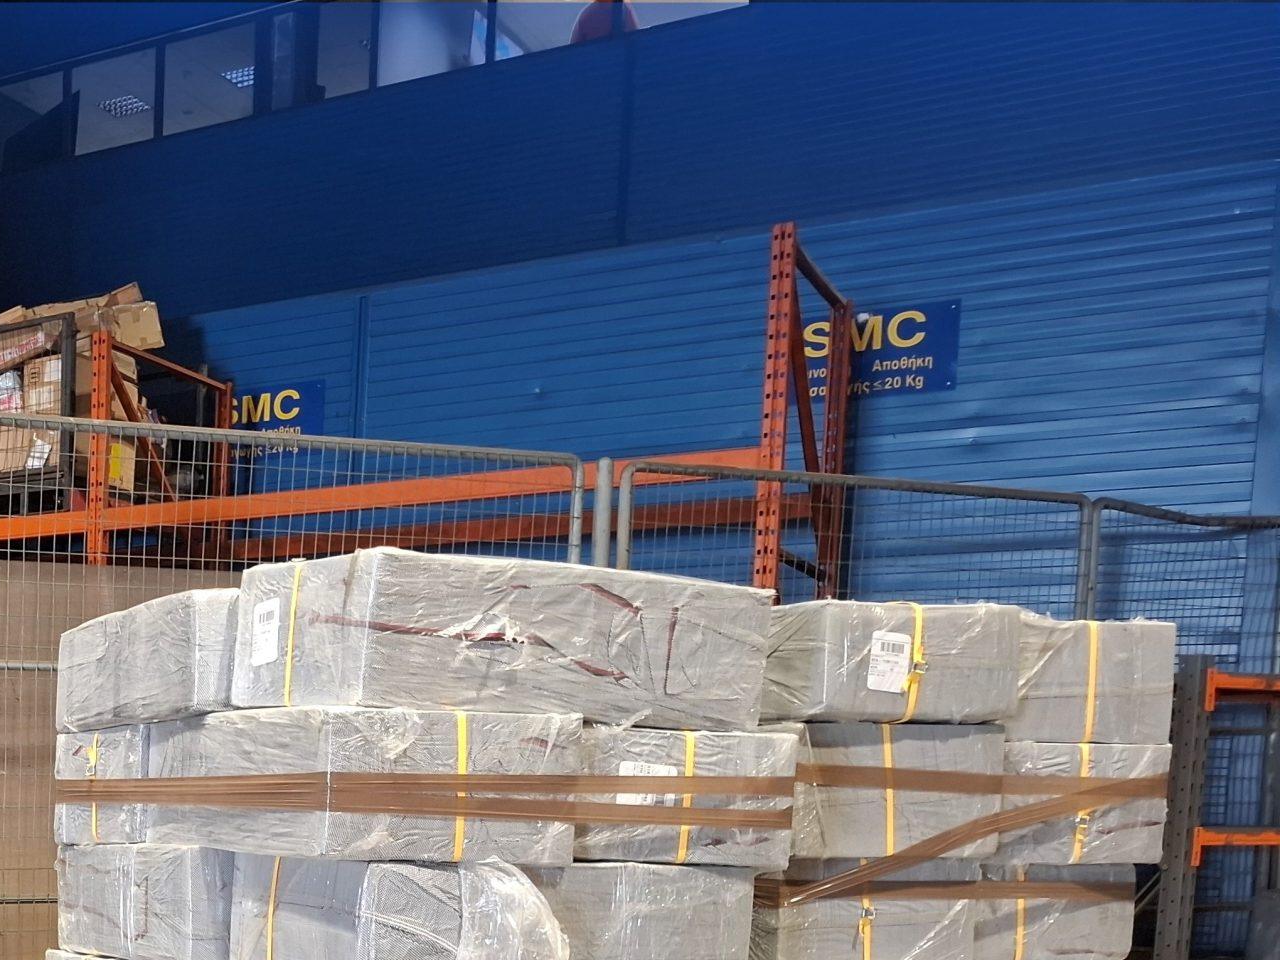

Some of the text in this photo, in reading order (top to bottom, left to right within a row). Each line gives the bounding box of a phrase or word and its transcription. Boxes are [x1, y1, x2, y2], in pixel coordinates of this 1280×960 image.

[803, 311, 926, 358] SMC
[872, 355, 933, 371] Αποθήκη
[906, 374, 924, 389] Kg
